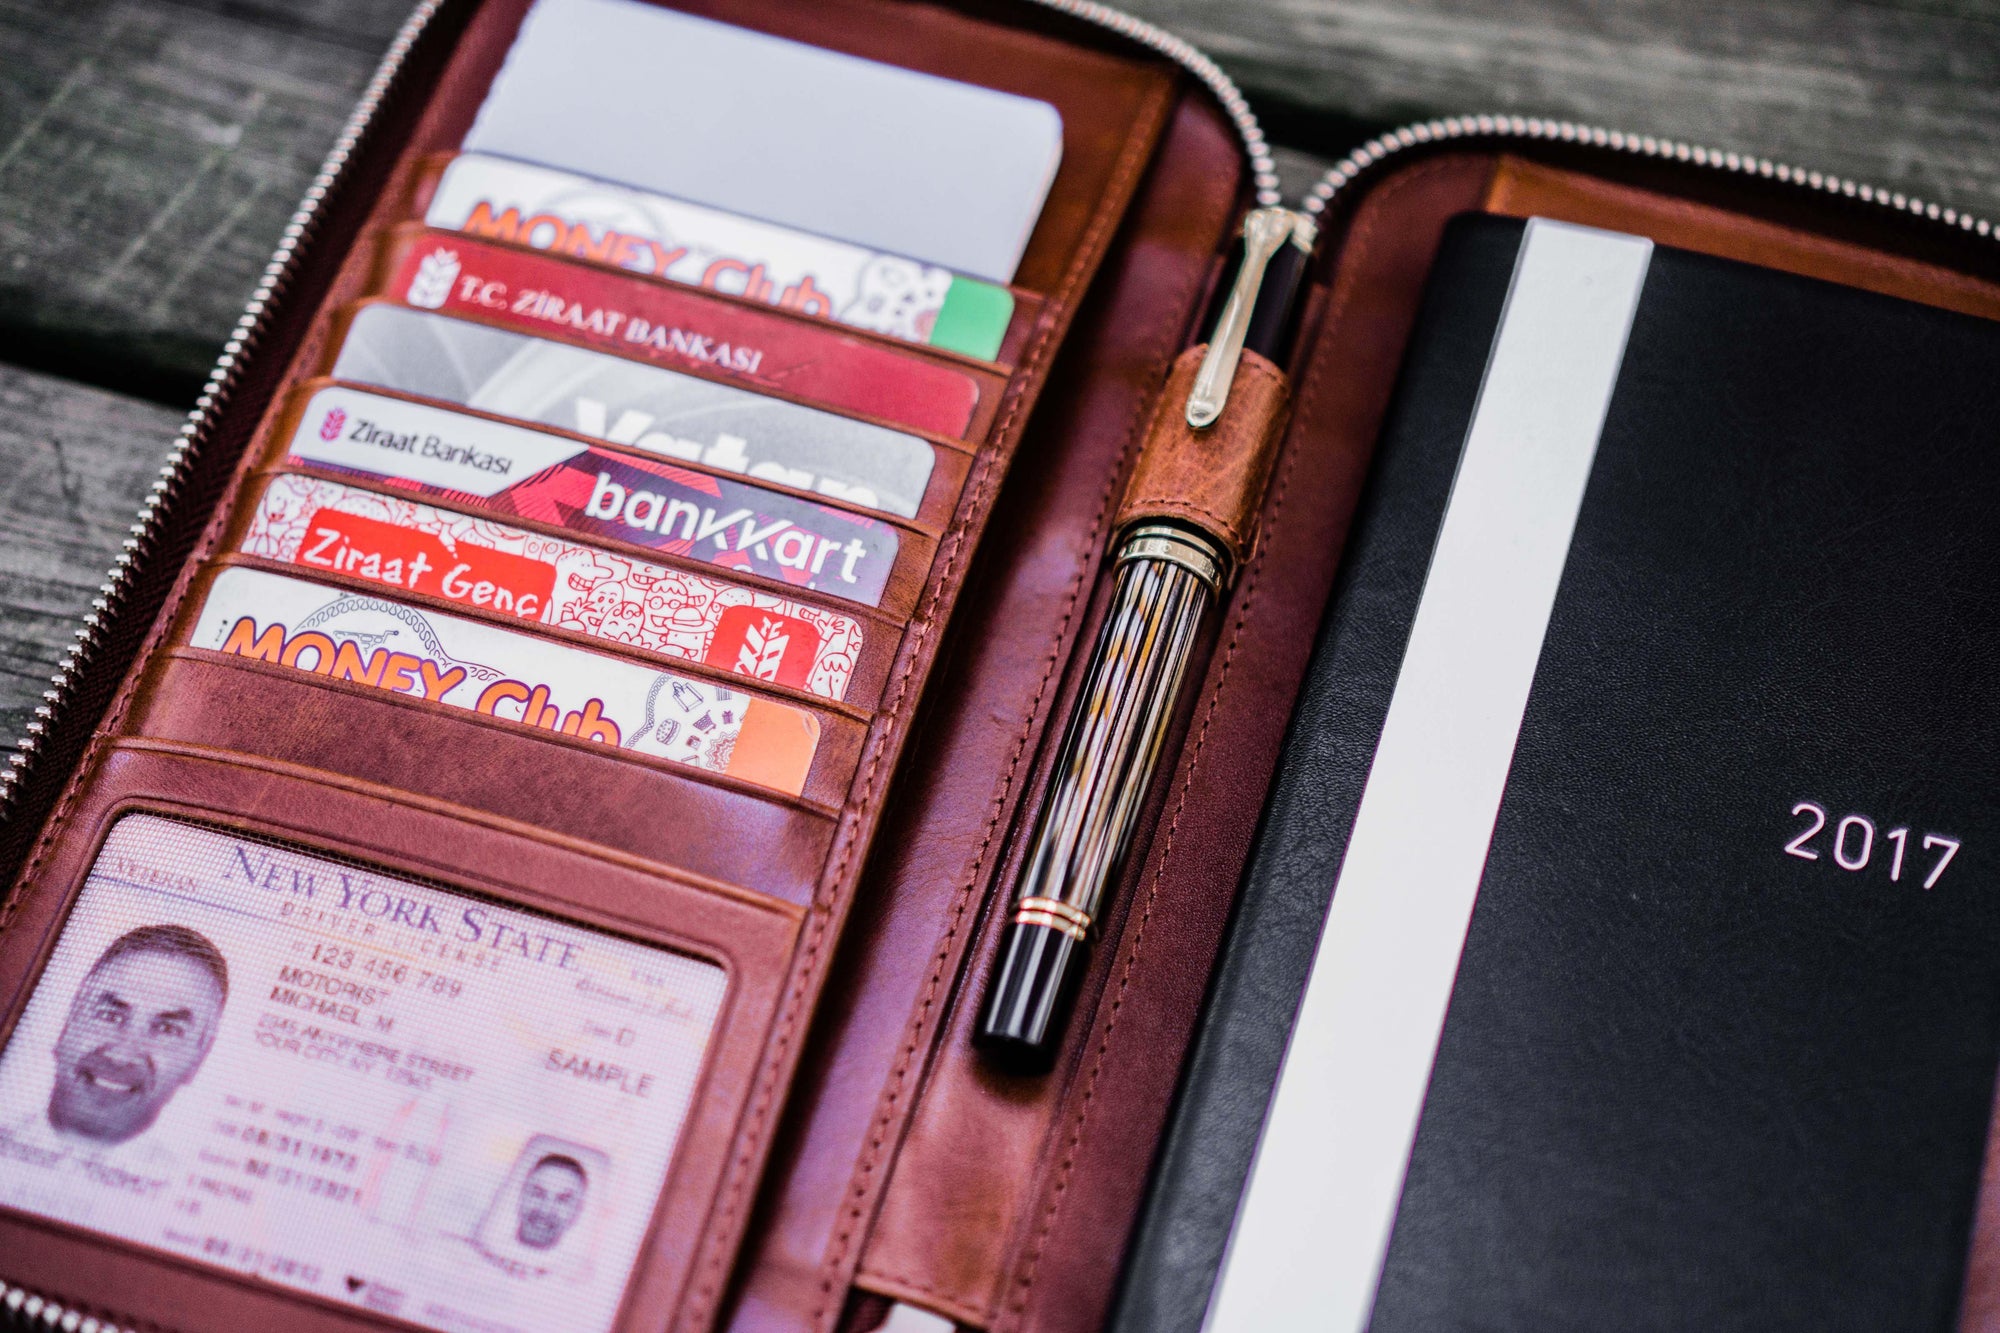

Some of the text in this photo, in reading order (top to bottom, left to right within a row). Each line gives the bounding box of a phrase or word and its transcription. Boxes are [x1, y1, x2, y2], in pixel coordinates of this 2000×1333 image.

[462, 200, 687, 277] MONEY
[461, 275, 507, 309] T.C.
[625, 318, 764, 373] BANKASI
[349, 418, 419, 453] Ziraat
[303, 528, 433, 589] Ziraat
[220, 616, 468, 703] MONEY
[1784, 803, 1960, 889] 2017
[280, 901, 377, 936] DRIVER
[335, 872, 442, 935] YORK
[456, 906, 584, 970] STATE
[311, 943, 355, 970] 123
[364, 958, 410, 984] 456
[418, 970, 463, 998] 789
[269, 986, 361, 1026] MICHAEL
[546, 1047, 655, 1098] SAMPLE
